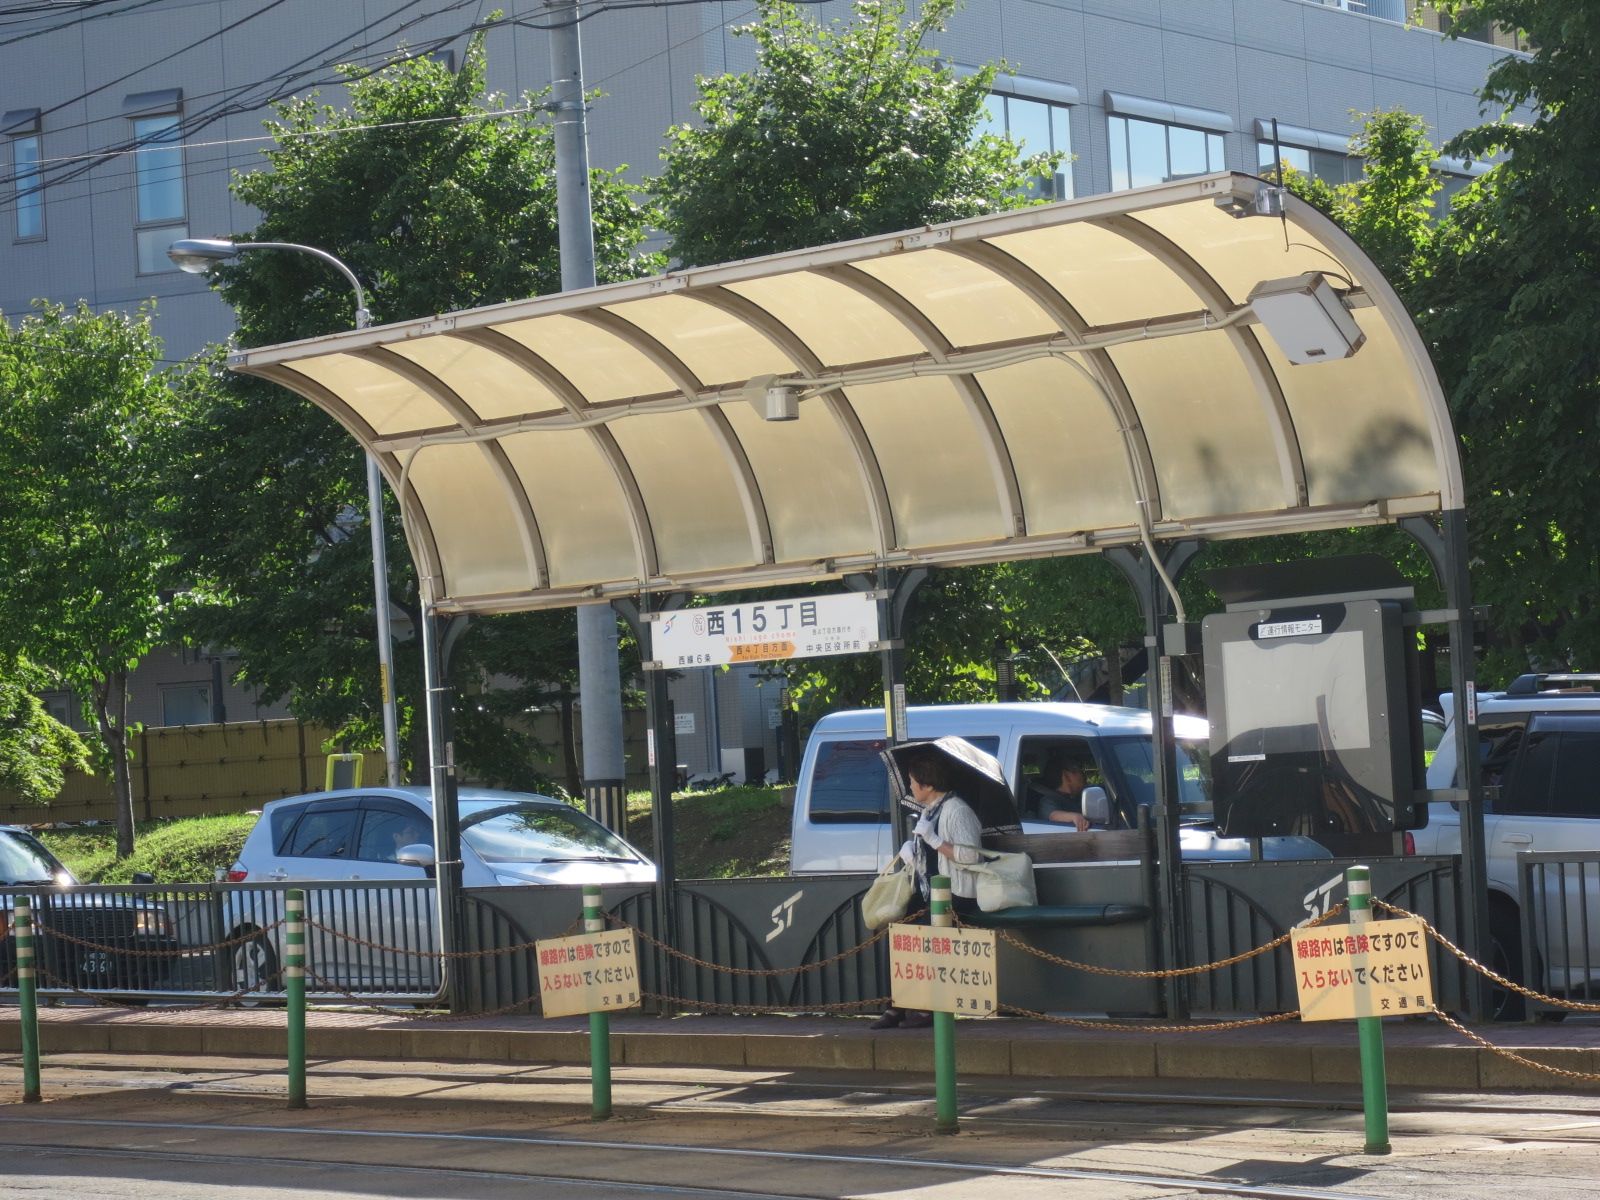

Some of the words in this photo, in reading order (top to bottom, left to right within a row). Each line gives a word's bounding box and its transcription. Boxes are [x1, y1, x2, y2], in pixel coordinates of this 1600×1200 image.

[706, 601, 818, 636] 西15丁目
[1266, 622, 1321, 637] 運行情報モニター
[678, 653, 711, 665] 西線6条
[736, 642, 788, 655] 西4丁目方面
[806, 640, 861, 653] 中央区役所前
[540, 938, 631, 966] 線路内は危険ですので
[892, 933, 992, 958] 線路内は危険ですので
[1296, 930, 1420, 960] 線路内は危険ですので
[543, 965, 635, 993] 入らないでください
[894, 962, 992, 987] 入らないでください
[1301, 963, 1424, 990] 入らないでください
[956, 997, 992, 1011] 交通局
[1380, 995, 1425, 1010] 交通局
